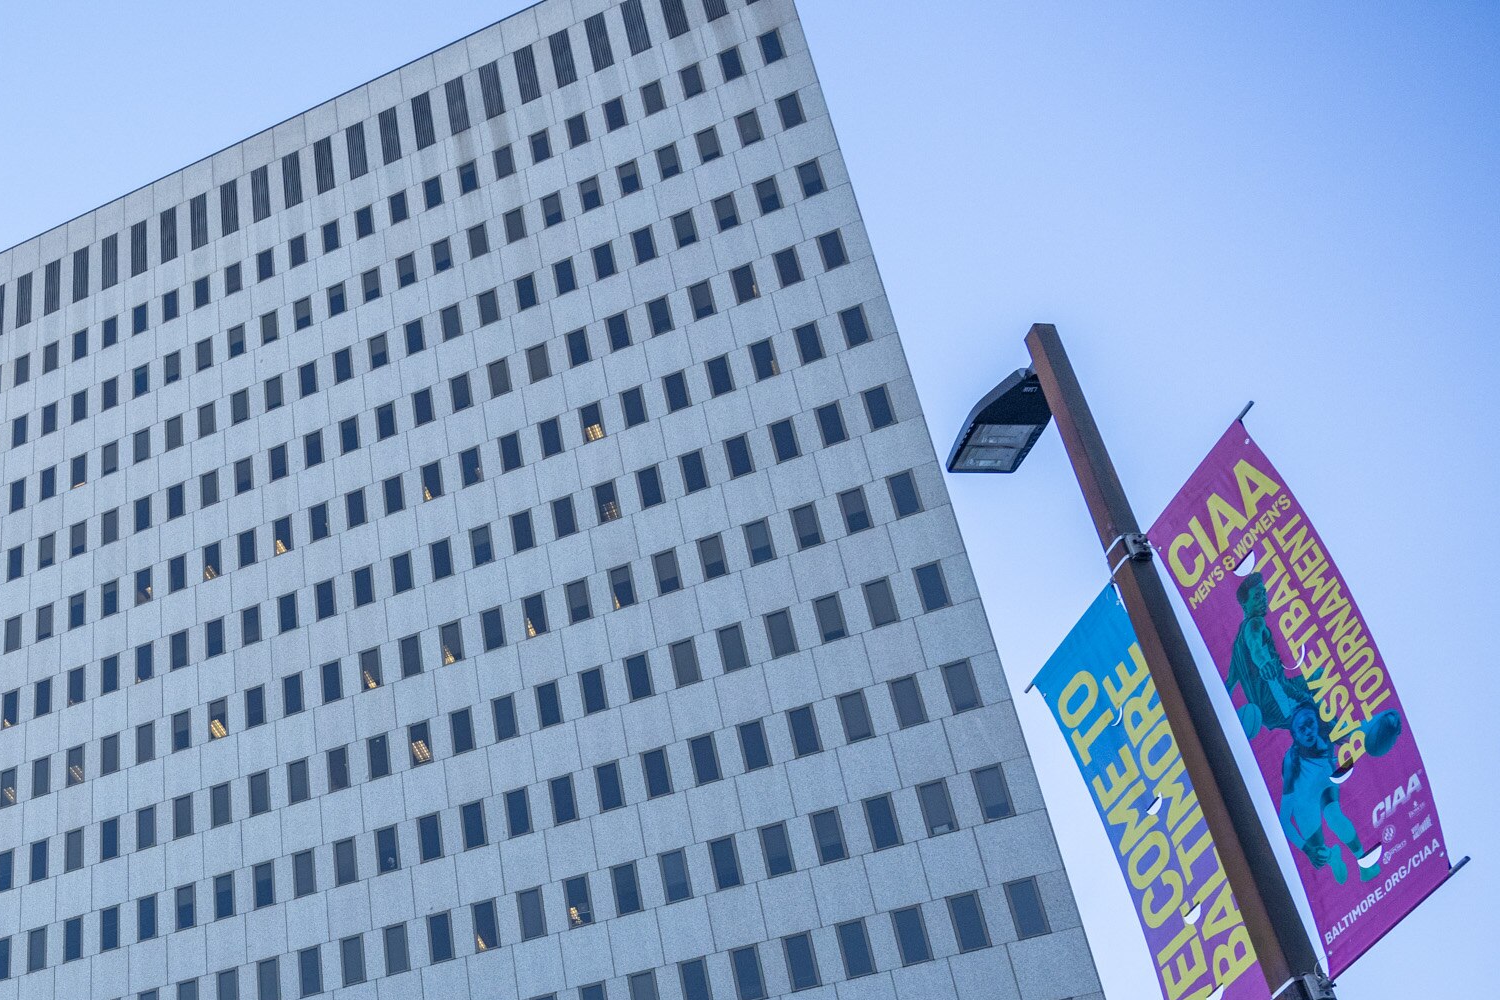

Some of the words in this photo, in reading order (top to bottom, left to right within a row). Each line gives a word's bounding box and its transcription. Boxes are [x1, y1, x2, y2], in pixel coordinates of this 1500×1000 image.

[1168, 458, 1281, 588] CIAA
[1188, 565, 1225, 610] MEN'S
[1222, 555, 1236, 571] &
[1233, 494, 1292, 561] WOMEN'S
[1251, 536, 1367, 769] BASKETBALL
[1272, 513, 1391, 722] TOURNAMENT
[1057, 670, 1114, 767] TO
[1102, 641, 1258, 990] BALTIMORE
[1372, 773, 1422, 829] CIAA
[1324, 838, 1441, 946] BALTIMORE.ORG/CIAA
